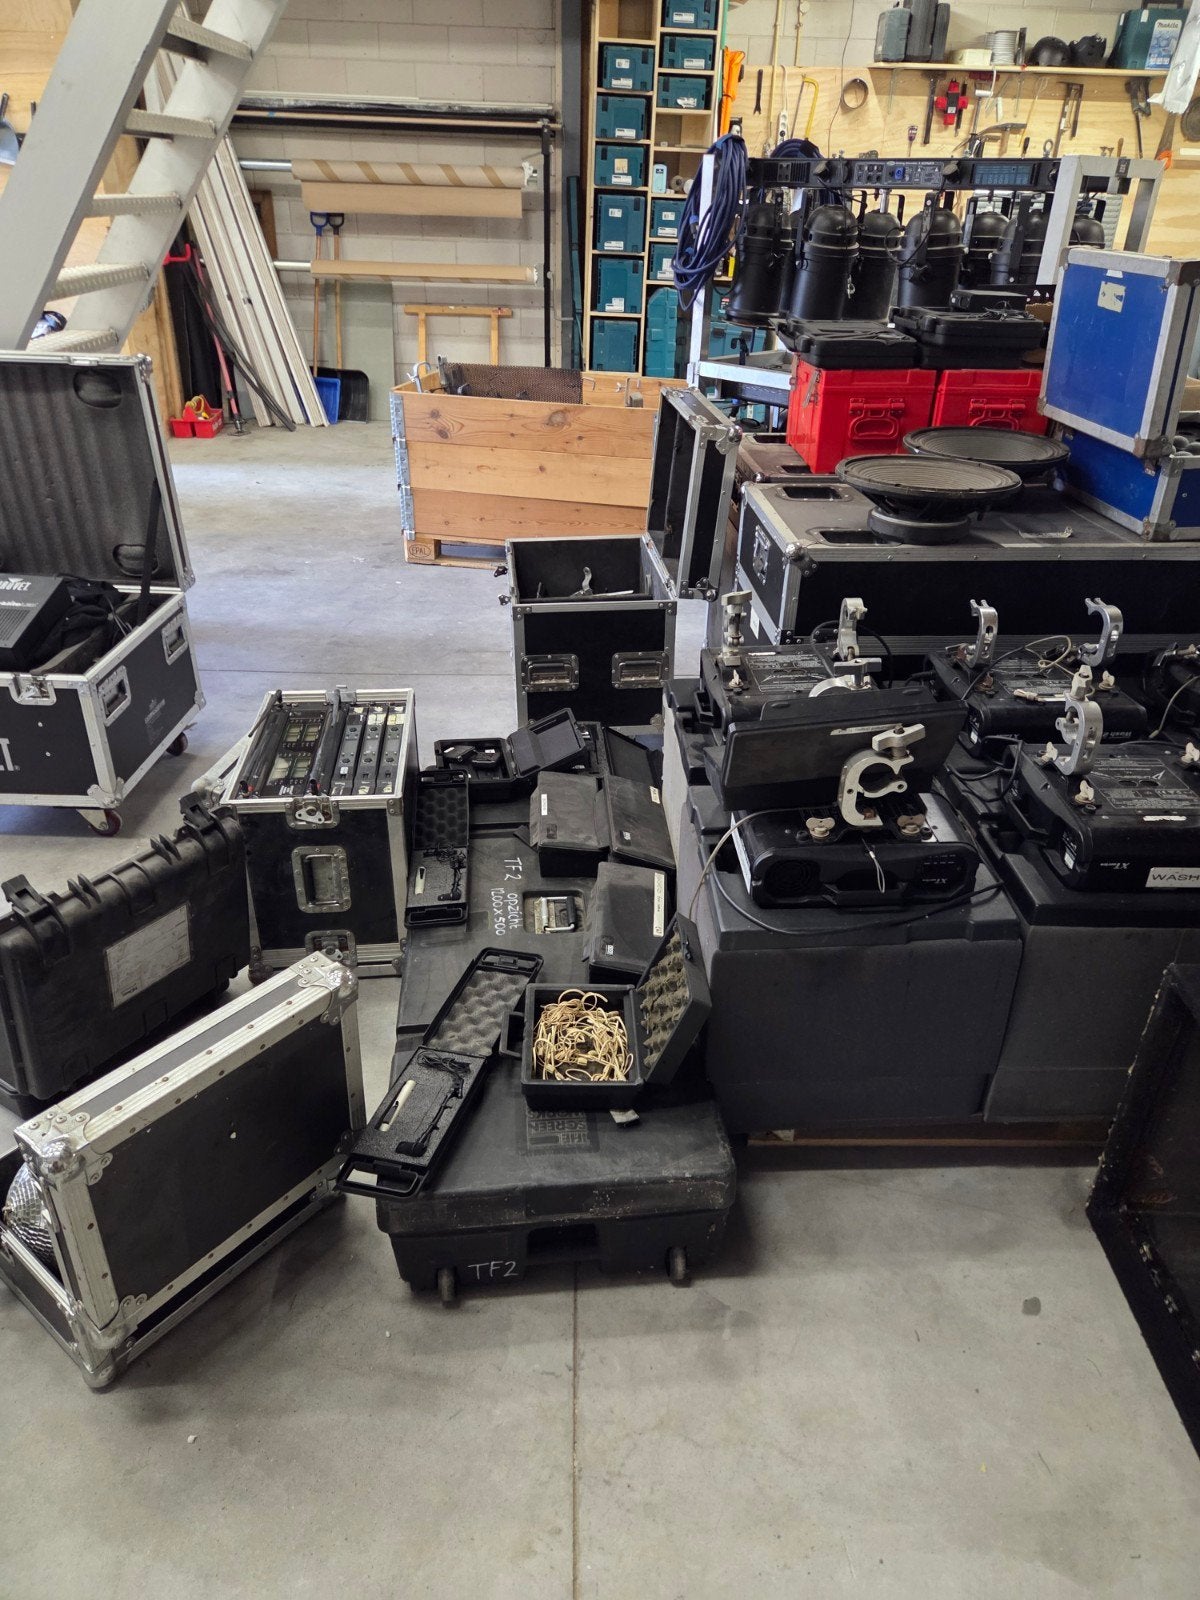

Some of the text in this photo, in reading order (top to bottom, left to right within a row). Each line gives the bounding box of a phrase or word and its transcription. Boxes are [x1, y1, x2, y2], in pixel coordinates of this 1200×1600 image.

[411, 546, 427, 555] EPAL
[1152, 873, 1200, 881] WASH
[503, 893, 524, 930] opzicht
[527, 1120, 586, 1133] SCREEN
[560, 1132, 588, 1145] THE
[467, 1261, 519, 1280] TF2
